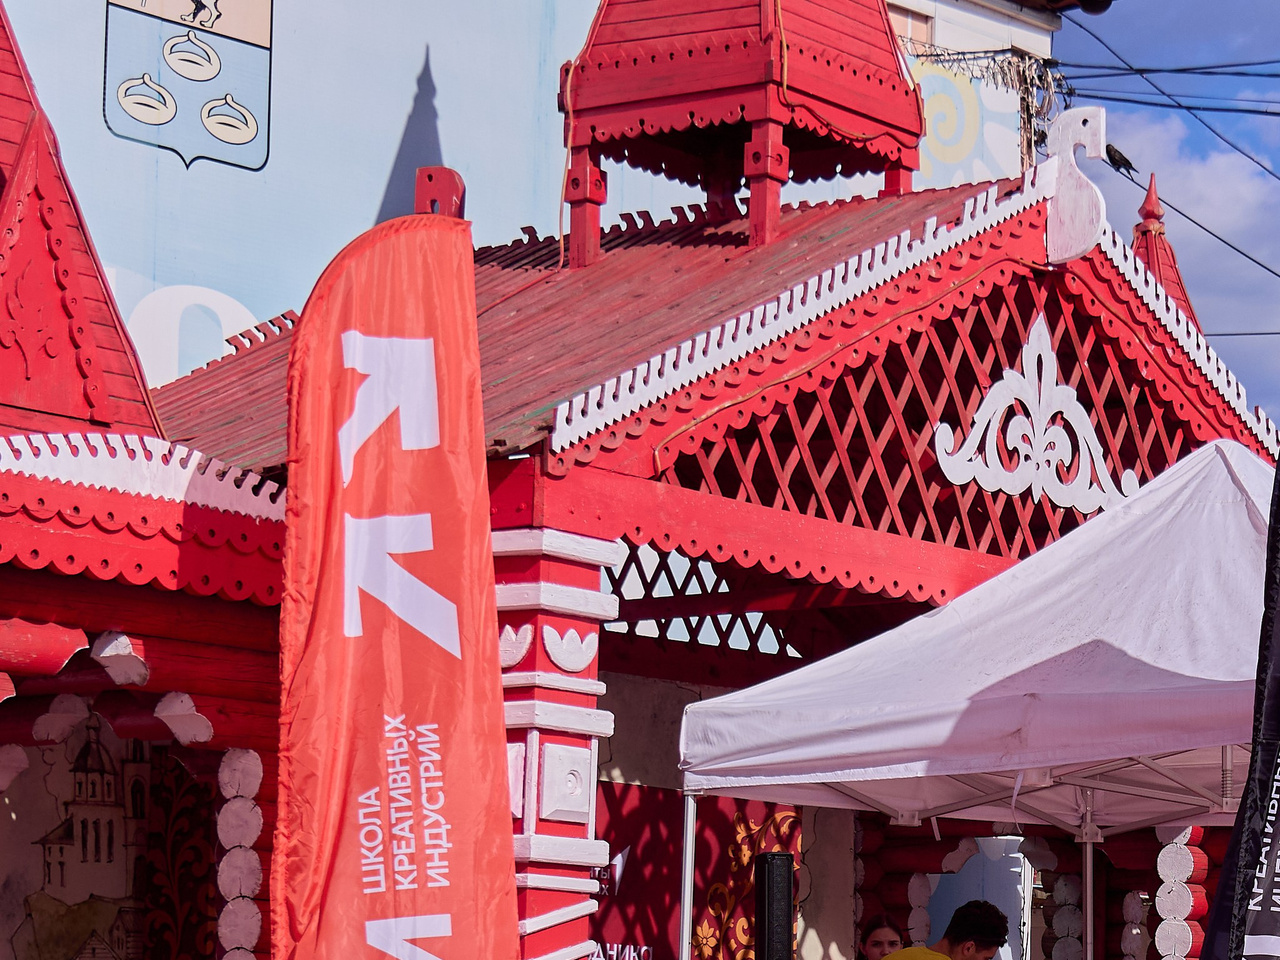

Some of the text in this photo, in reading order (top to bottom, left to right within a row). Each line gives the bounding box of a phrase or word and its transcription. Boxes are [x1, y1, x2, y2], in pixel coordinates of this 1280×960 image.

[359, 786, 387, 895] ШКОЛА
[384, 713, 418, 890] КРЕАТИВНЫХ
[408, 723, 452, 888] ИНДУСТРИЙ
